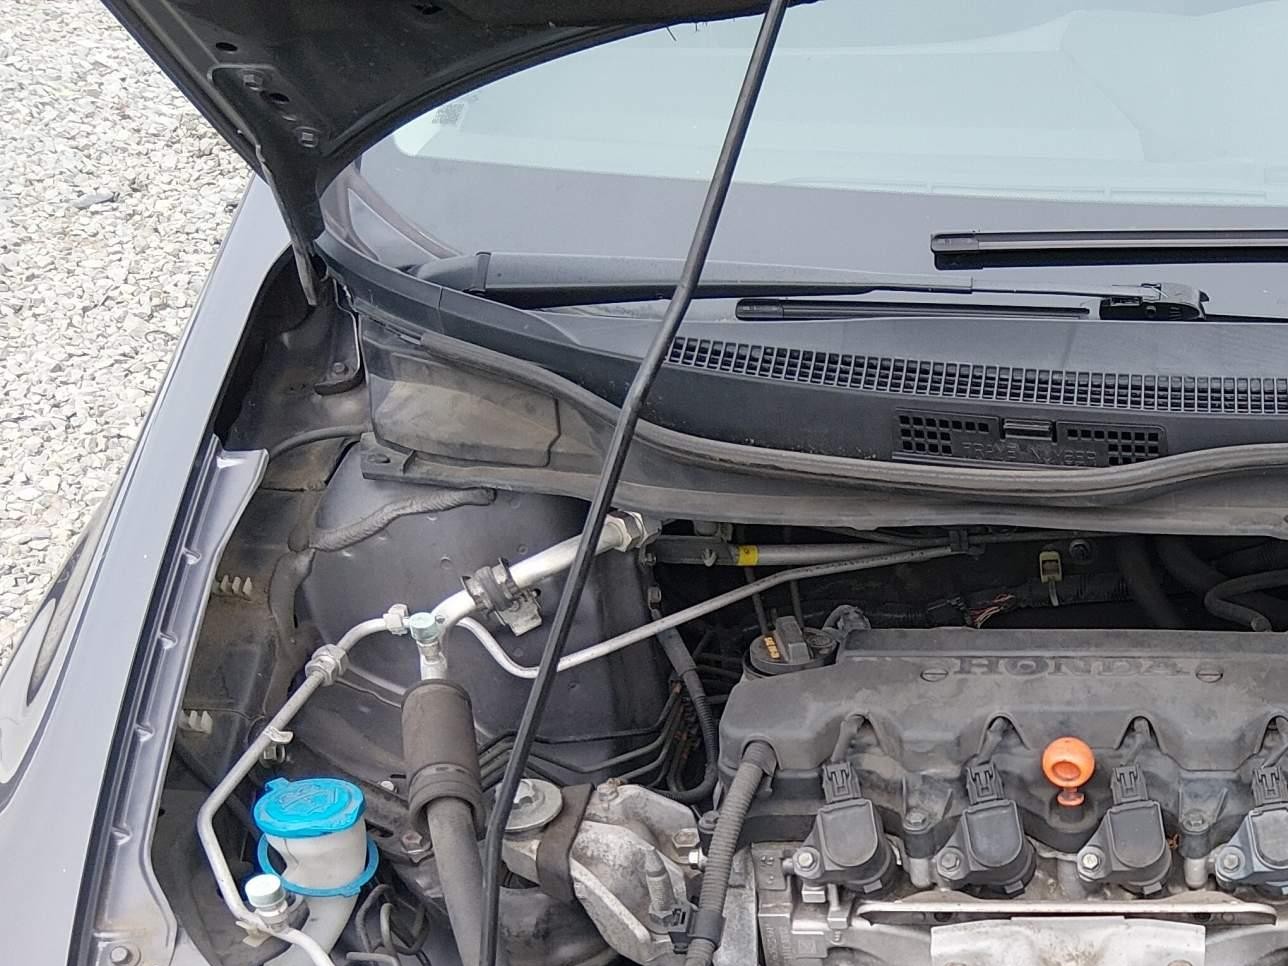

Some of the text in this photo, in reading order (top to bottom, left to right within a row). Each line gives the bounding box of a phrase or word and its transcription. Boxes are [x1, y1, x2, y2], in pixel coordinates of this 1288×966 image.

[962, 441, 1097, 465] FRAME NUMBER
[953, 656, 1190, 676] HONDA
